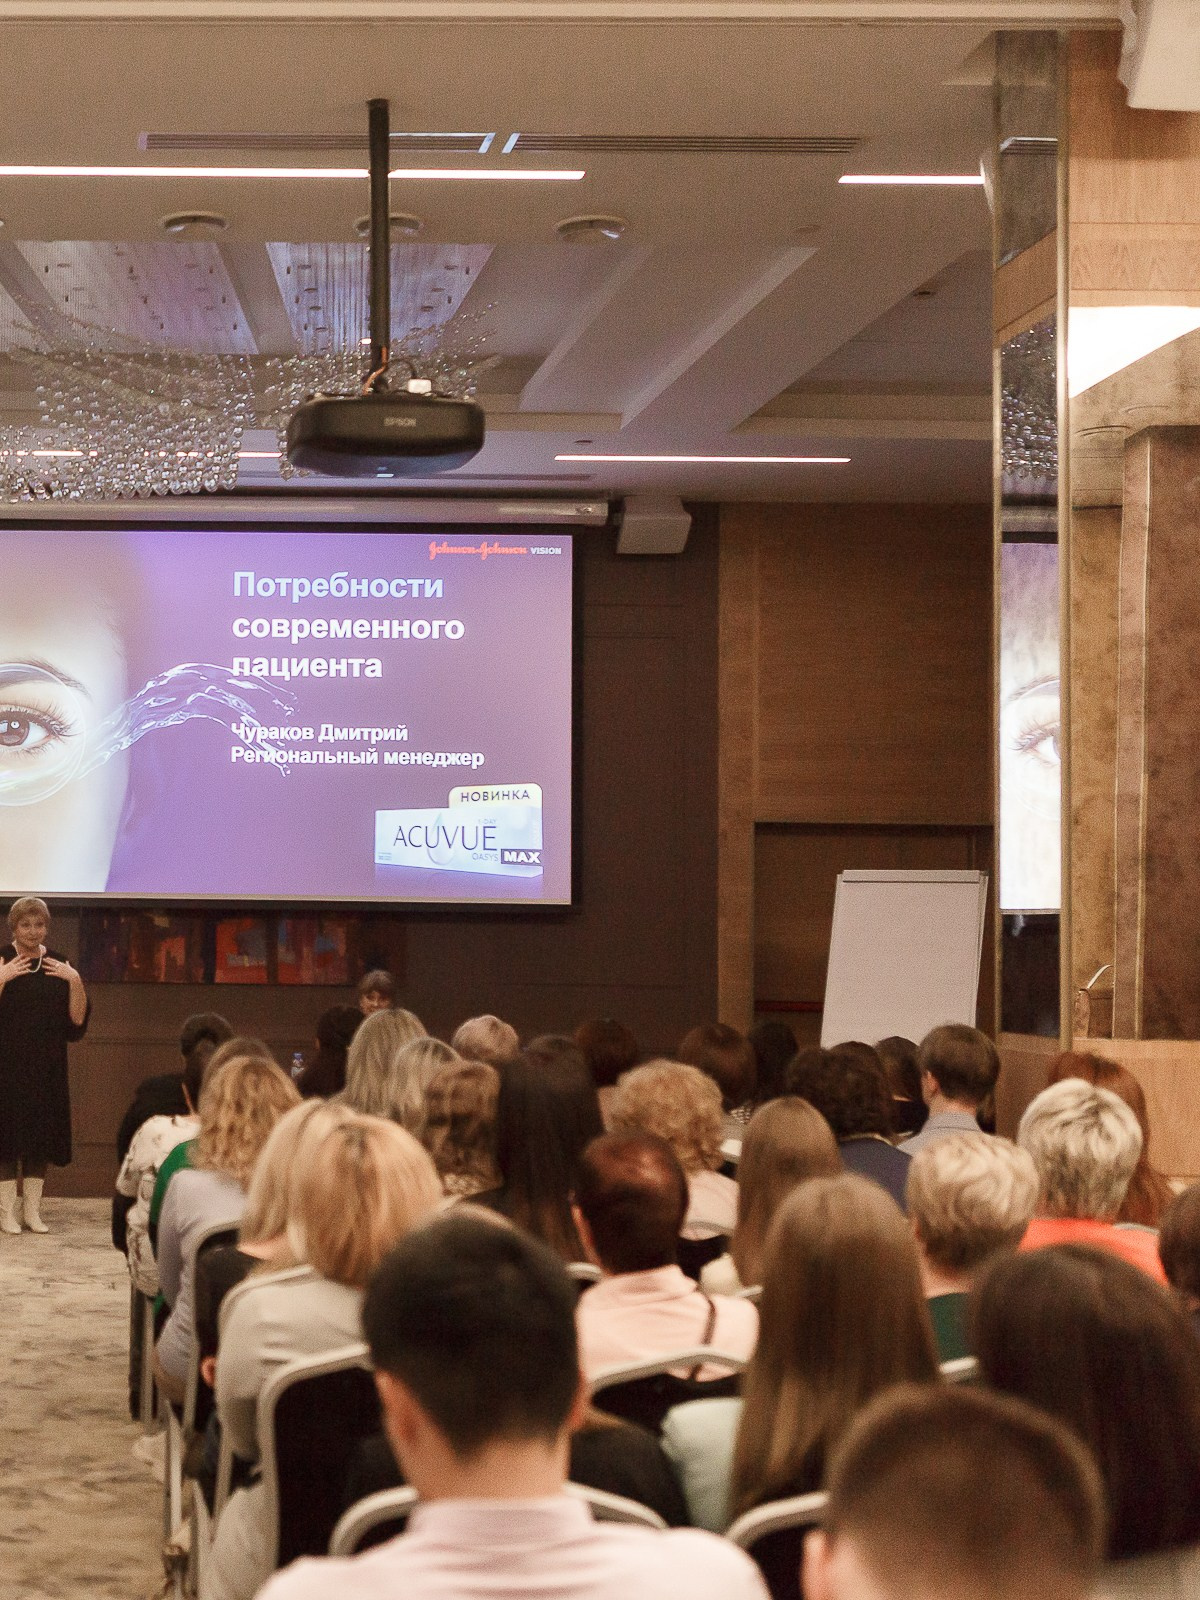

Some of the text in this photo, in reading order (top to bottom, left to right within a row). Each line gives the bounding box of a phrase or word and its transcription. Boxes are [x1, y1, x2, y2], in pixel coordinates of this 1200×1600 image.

[530, 547, 562, 555] VISION
[233, 571, 444, 603] Потребности
[232, 617, 465, 644] современного
[232, 656, 383, 681] пациента
[231, 722, 409, 744] Чураков Дмитрий
[231, 746, 485, 769] Региональный менеджер
[460, 789, 530, 802] НОВИНКА
[393, 825, 498, 851] ACUVUE
[472, 850, 541, 864] OASYS MAX
